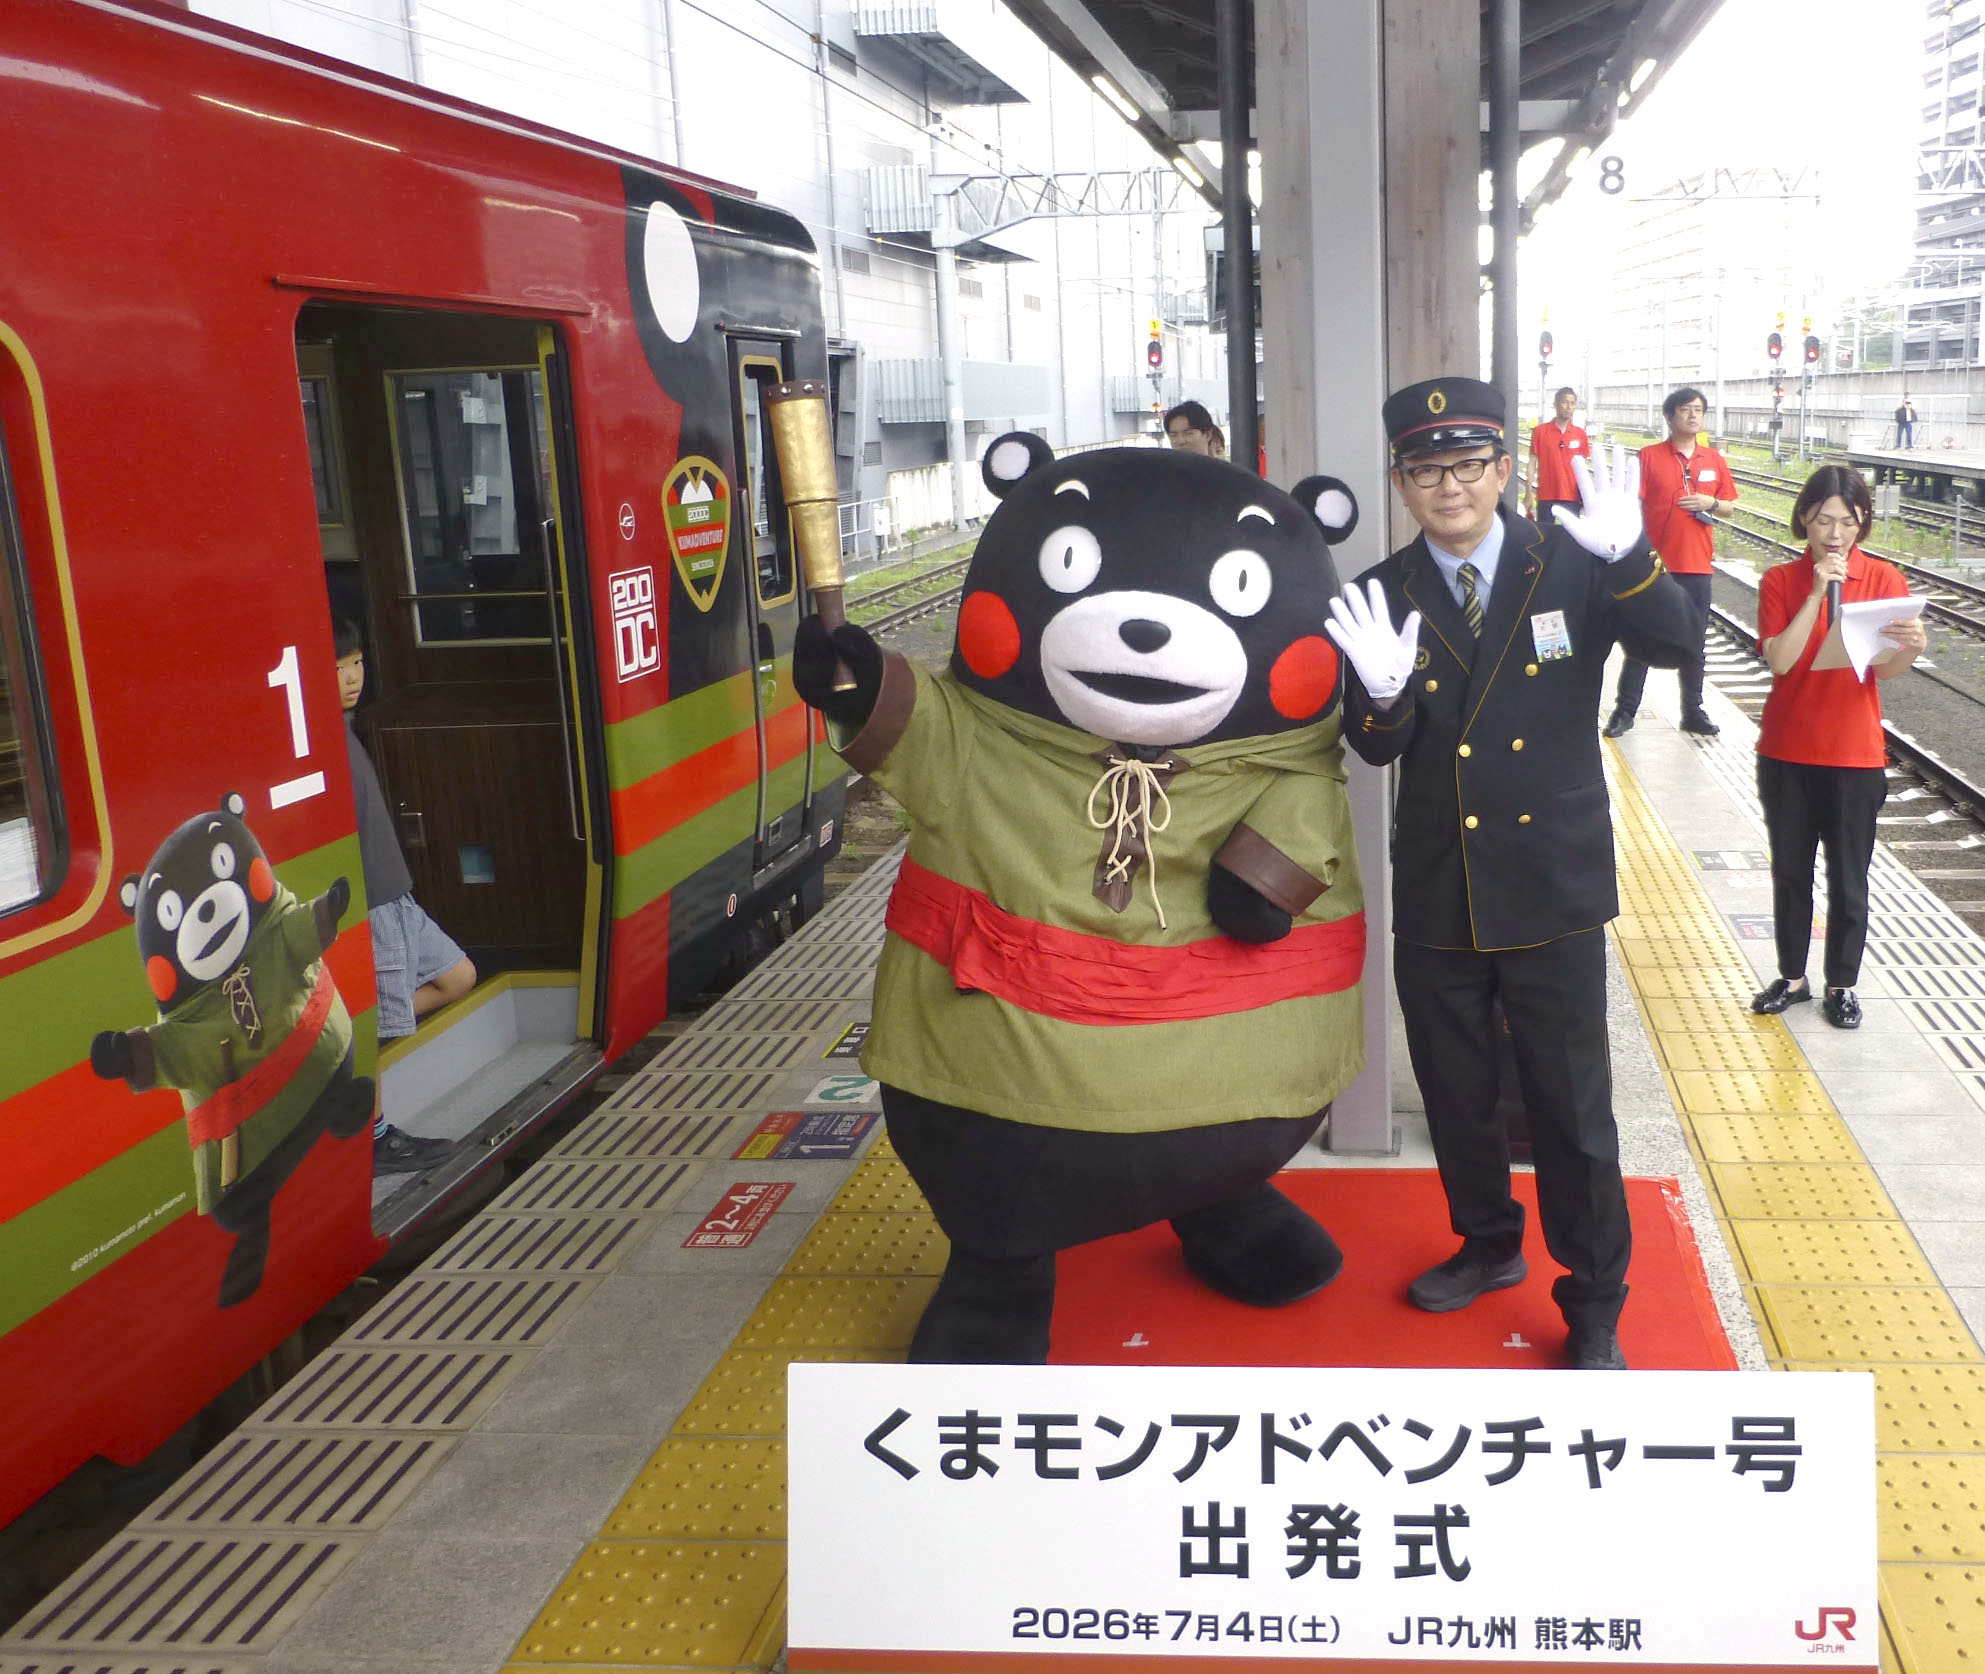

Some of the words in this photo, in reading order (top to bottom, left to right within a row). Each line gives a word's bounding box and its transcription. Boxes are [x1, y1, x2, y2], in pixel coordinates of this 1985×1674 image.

[1599, 156, 1625, 195] 8
[612, 573, 652, 611] 200
[615, 611, 657, 676] DC
[267, 645, 310, 759] 1
[864, 1408, 1803, 1493] くまモンアドベンチャー号
[1179, 1502, 1472, 1582] 出発式
[1388, 1615, 1516, 1650] JR九州
[1534, 1616, 1643, 1651] 熊本駅
[1795, 1607, 1857, 1641] JR
[1807, 1642, 1845, 1653] JR九州
